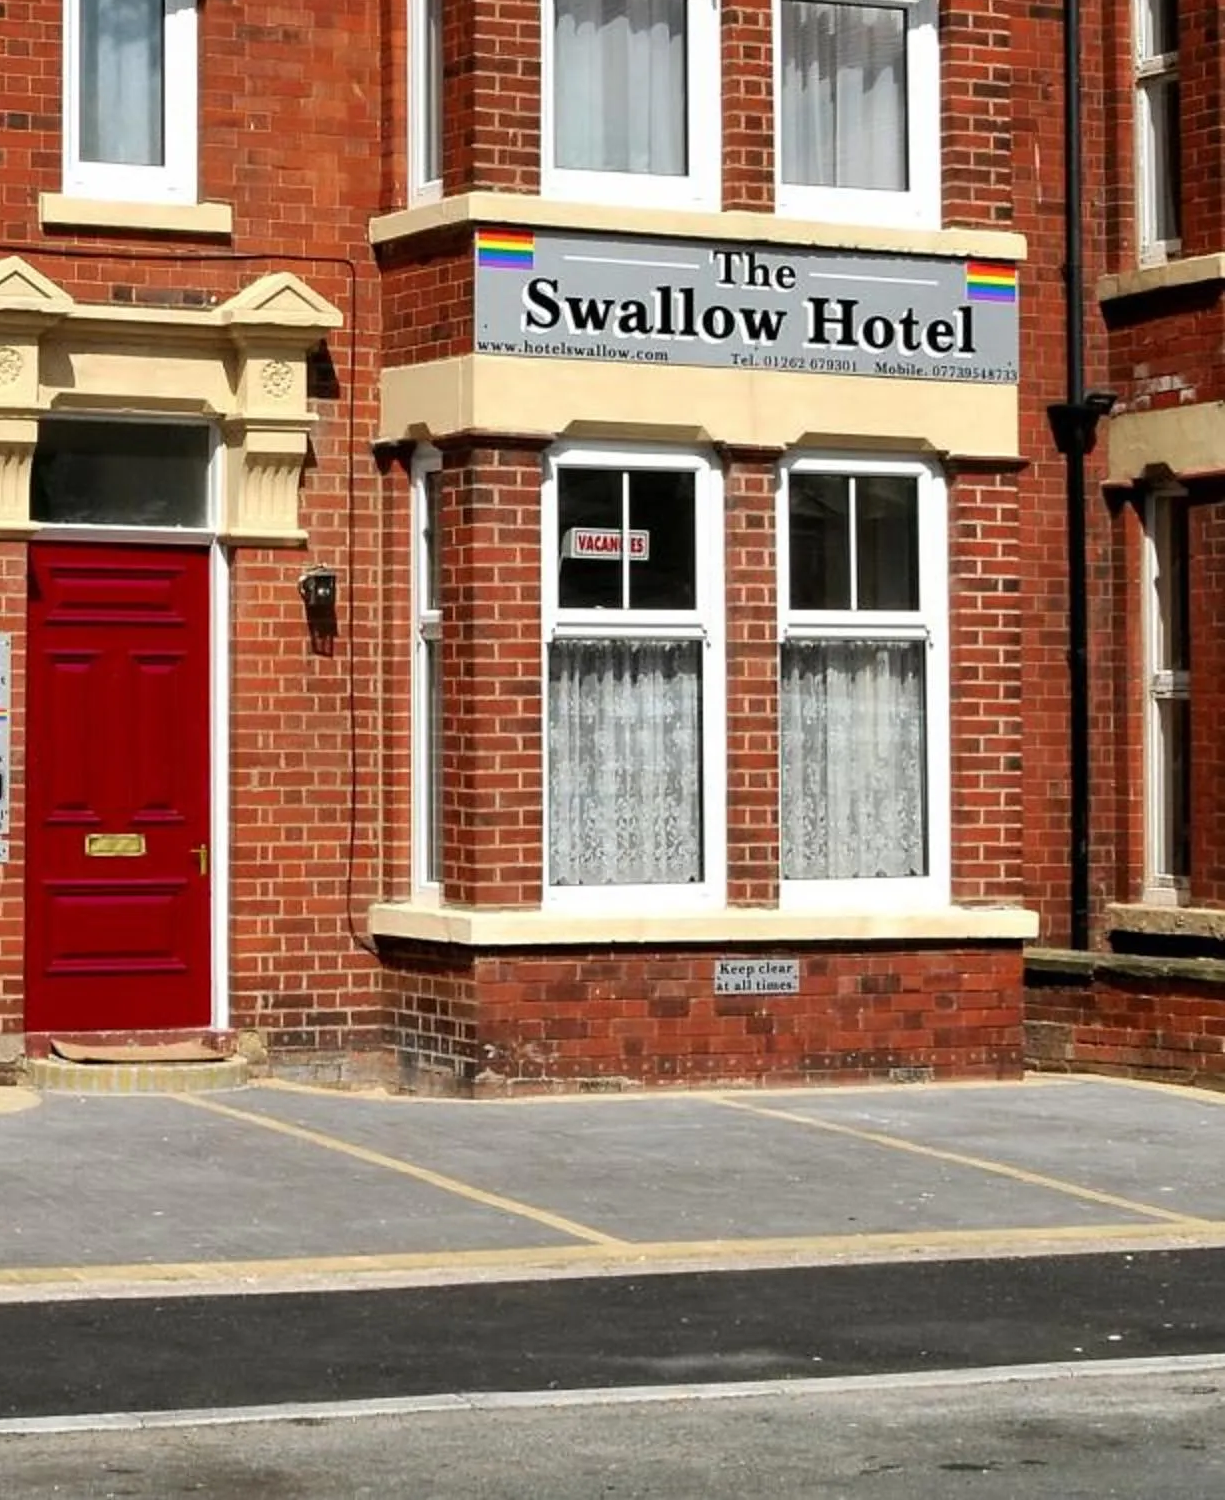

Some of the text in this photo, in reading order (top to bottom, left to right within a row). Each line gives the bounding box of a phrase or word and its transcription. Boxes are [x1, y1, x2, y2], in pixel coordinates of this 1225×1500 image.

[714, 250, 797, 289] The
[524, 278, 977, 354] Swallow Hotel
[478, 340, 669, 362] www.hotelswallow.com
[731, 352, 757, 366] Tel.
[763, 355, 806, 369] 01262
[874, 361, 927, 377] Mobile.
[578, 534, 644, 554] VACANES
[719, 962, 793, 978] Keep clear
[716, 981, 729, 991] at
[734, 979, 752, 991] all
